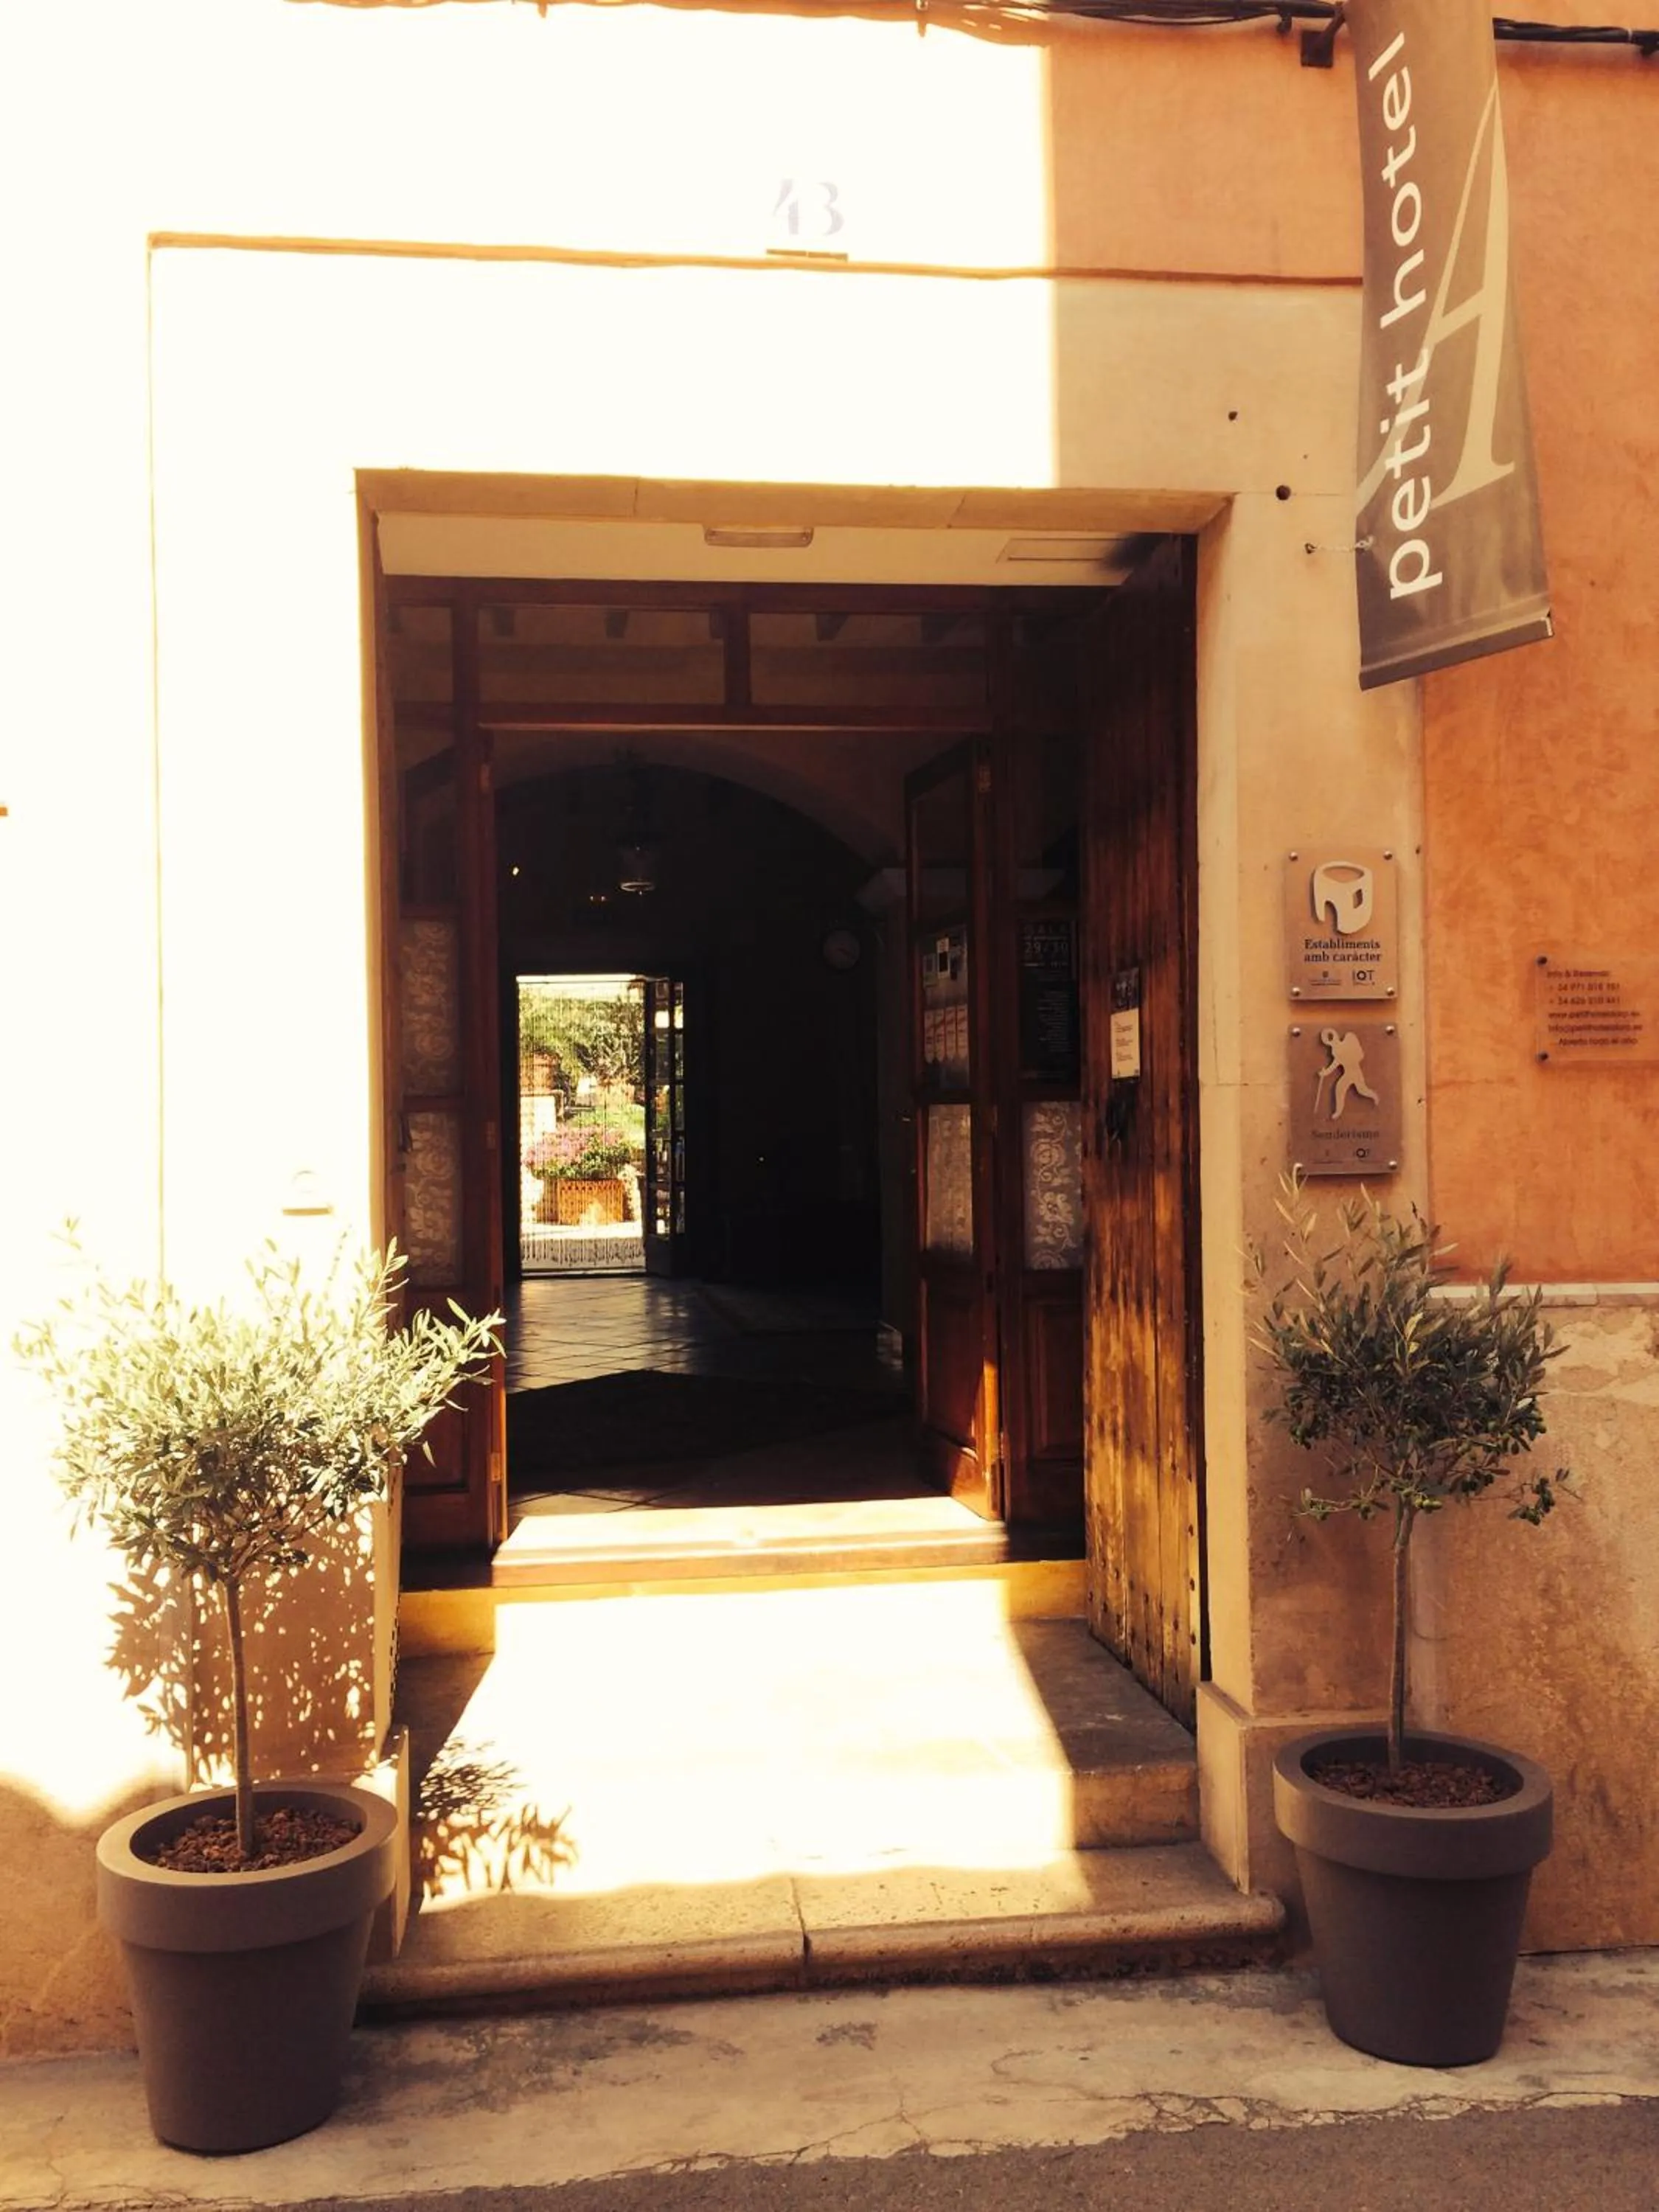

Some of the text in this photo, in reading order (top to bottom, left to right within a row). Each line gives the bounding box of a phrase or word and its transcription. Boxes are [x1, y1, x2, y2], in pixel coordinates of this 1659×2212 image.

[772, 177, 846, 237] 43
[1368, 32, 1443, 600] petit hotel
[1304, 950, 1329, 962] amb
